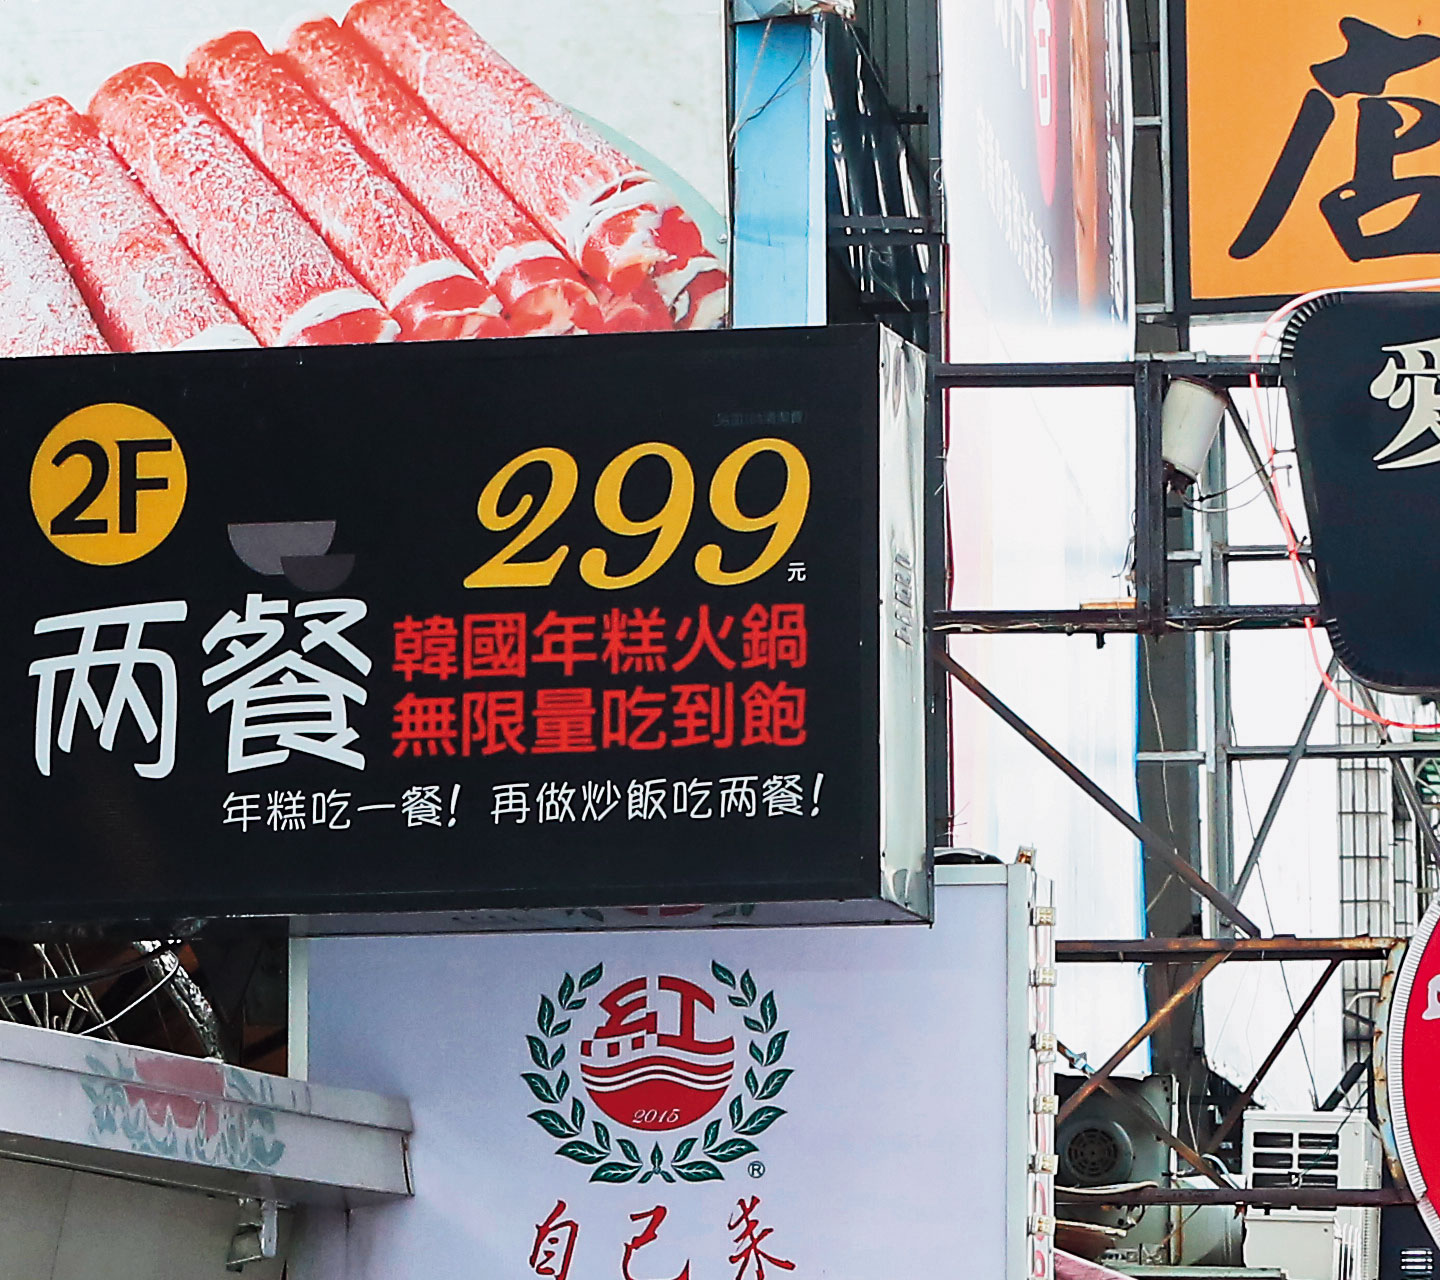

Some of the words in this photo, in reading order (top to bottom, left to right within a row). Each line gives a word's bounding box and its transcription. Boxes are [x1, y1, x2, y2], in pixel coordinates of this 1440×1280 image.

[49, 439, 172, 537] 2F
[393, 603, 806, 683] 韓國年糕火鍋
[392, 686, 806, 757] 無限量吃到飽
[632, 1107, 679, 1125] 2015
